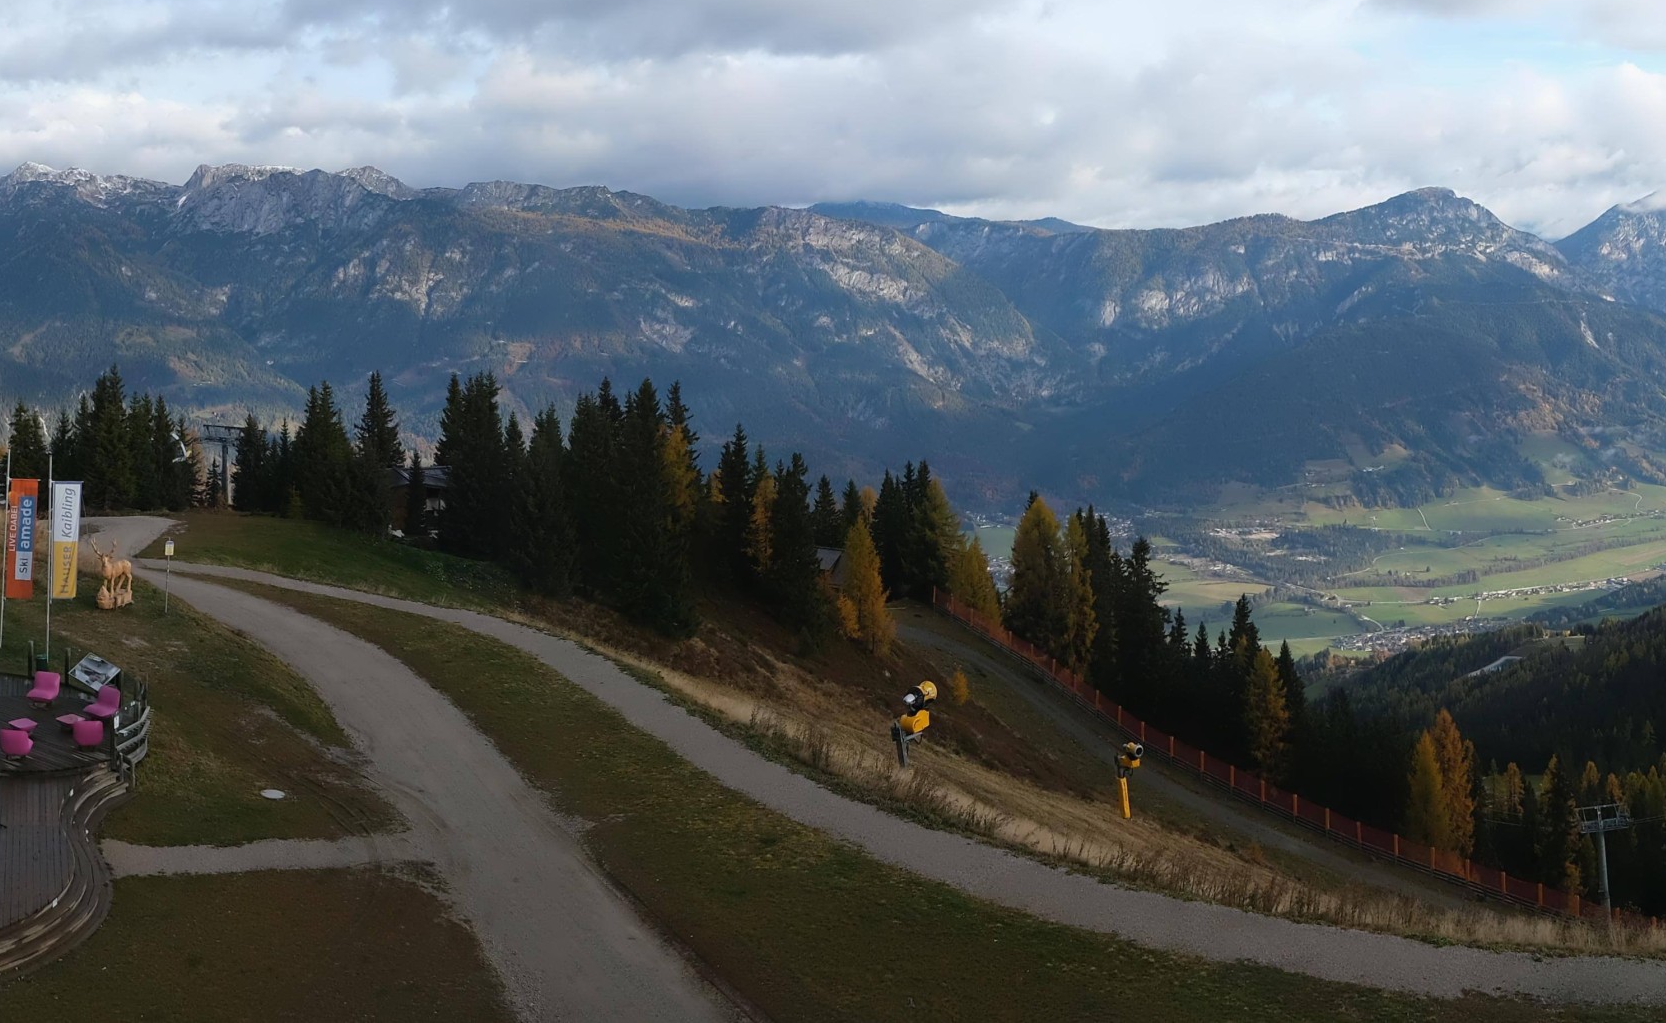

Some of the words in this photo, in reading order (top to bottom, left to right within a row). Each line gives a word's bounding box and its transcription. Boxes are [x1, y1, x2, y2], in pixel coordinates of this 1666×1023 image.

[10, 505, 18, 532] DABEI
[20, 498, 33, 549] amade
[61, 487, 77, 538] Kaibling
[8, 533, 17, 552] LIVE
[19, 558, 28, 573] Ski
[61, 545, 72, 594] HAUSER
